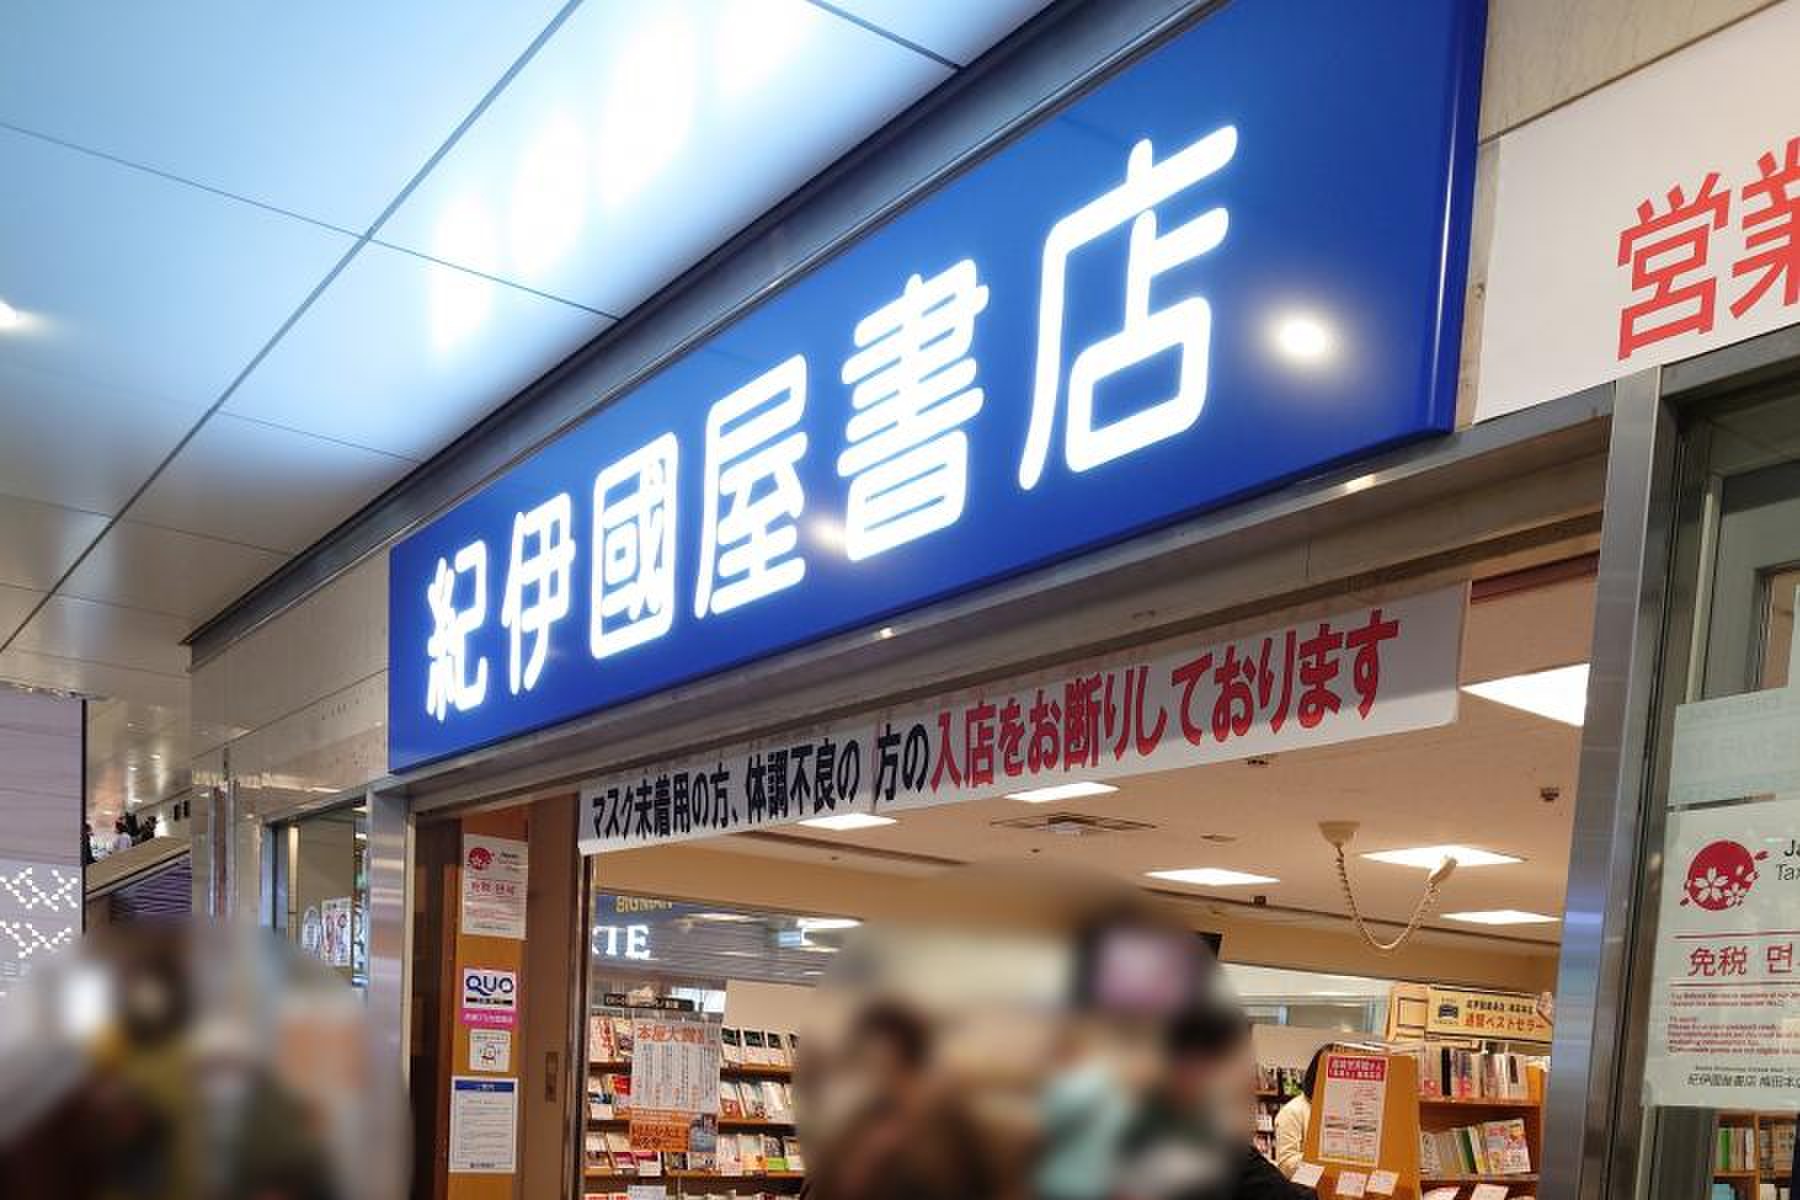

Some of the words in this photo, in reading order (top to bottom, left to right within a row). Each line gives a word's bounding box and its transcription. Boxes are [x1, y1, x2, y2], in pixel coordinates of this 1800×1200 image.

[425, 123, 1239, 722] 紀伊國屋書店
[1688, 947, 1747, 977] 免税
[1767, 943, 1800, 974] 면
[466, 975, 514, 996] QUO
